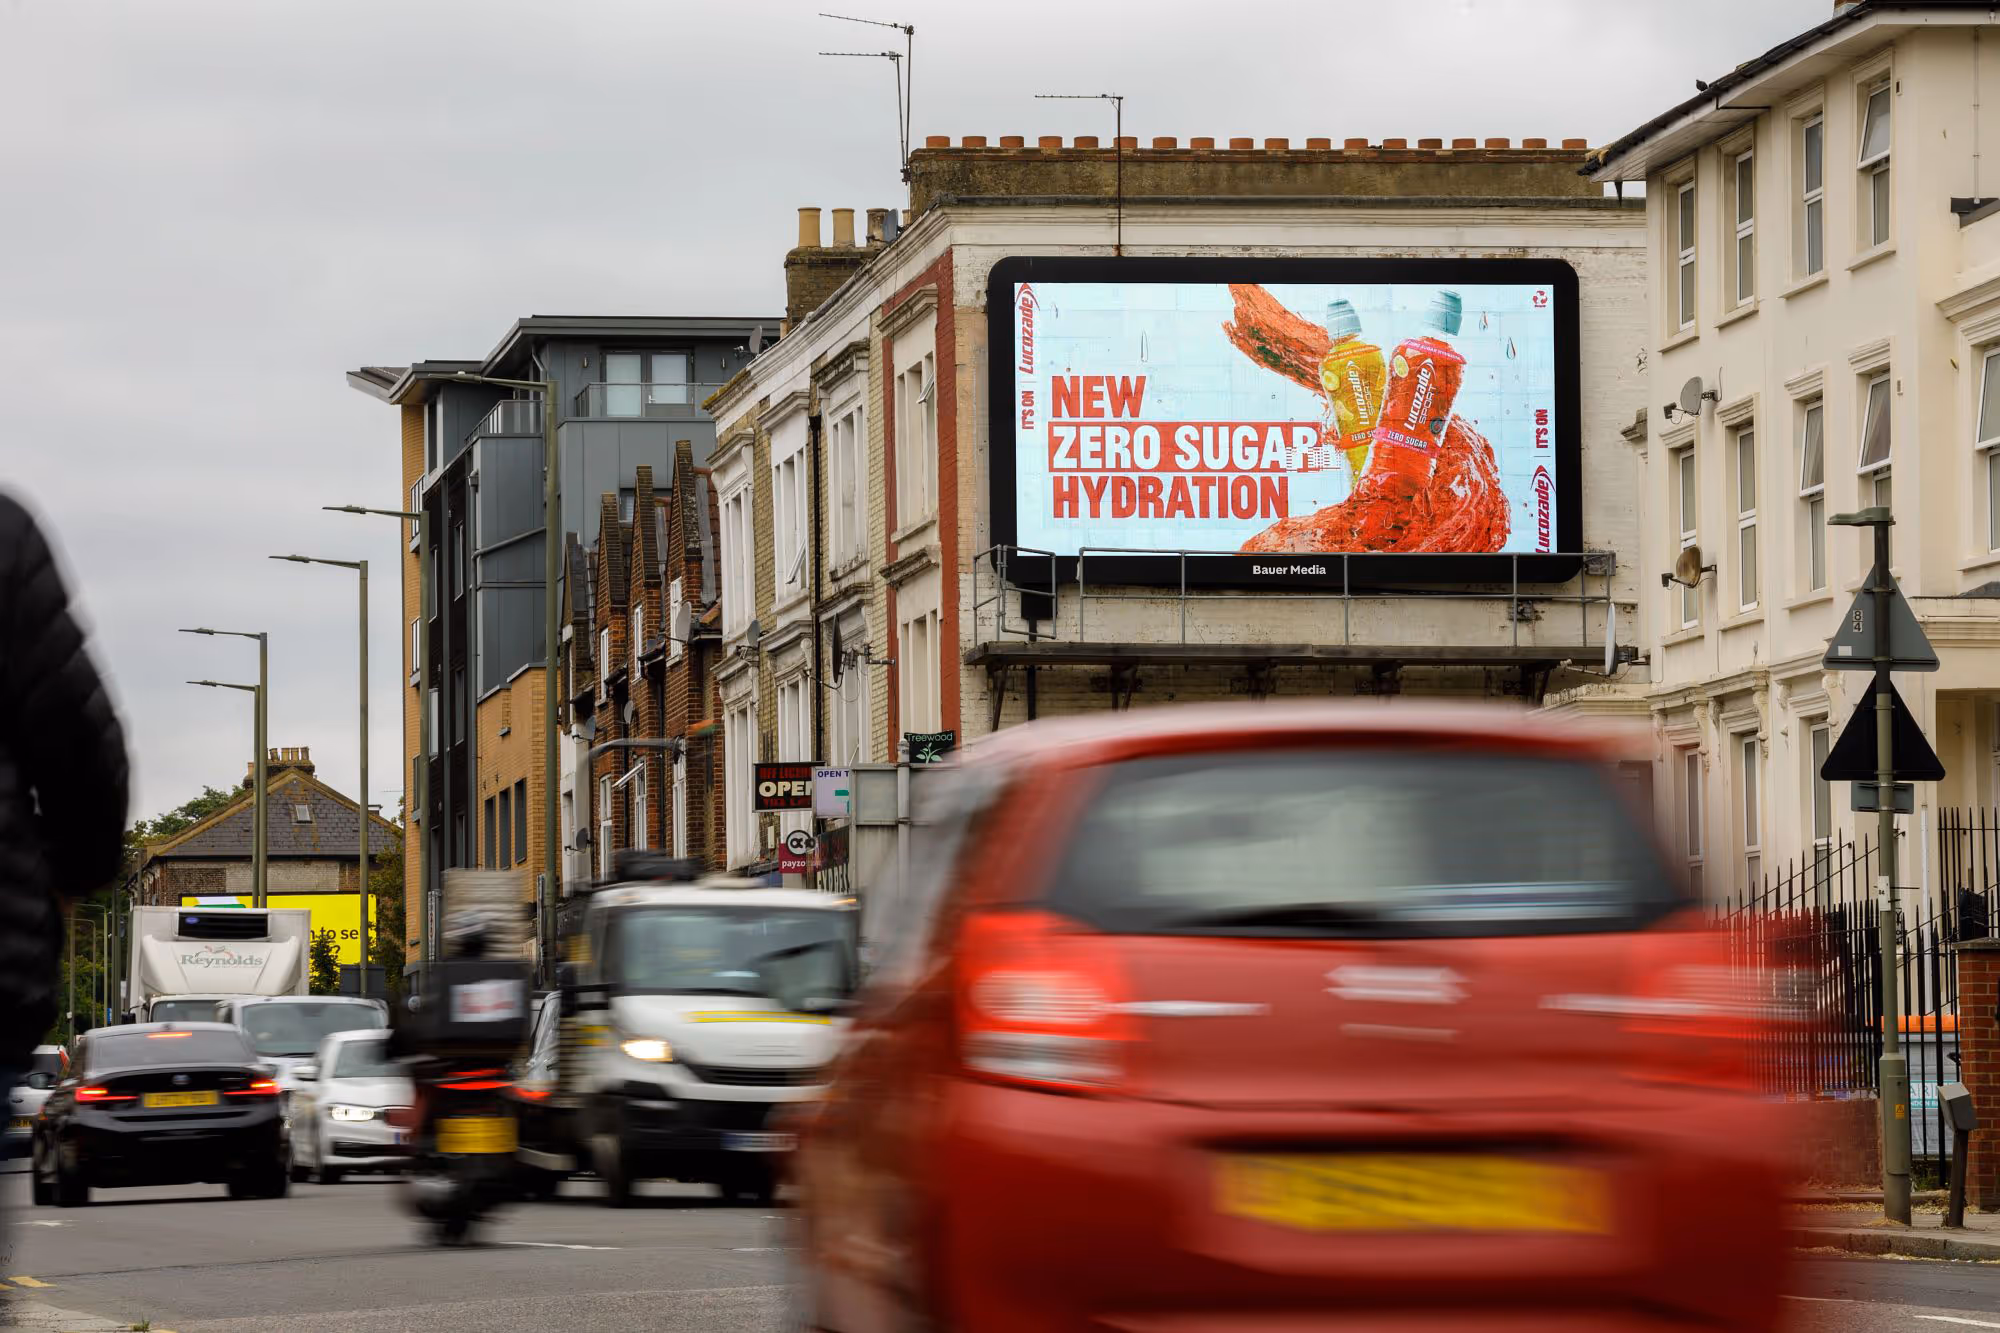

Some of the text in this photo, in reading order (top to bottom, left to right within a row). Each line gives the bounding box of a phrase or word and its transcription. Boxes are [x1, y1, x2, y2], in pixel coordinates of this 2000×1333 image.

[1019, 297, 1034, 375] Lucozade
[1021, 391, 1035, 407] ON
[1051, 375, 1147, 419] NEW
[1404, 367, 1431, 431] Lucozade
[1419, 384, 1437, 425] SPORT
[1535, 409, 1549, 426] ON
[1052, 424, 1319, 470] ZERO SUGAR
[1387, 431, 1404, 442] ZERO
[1405, 436, 1428, 449] SUGAR
[1053, 475, 1289, 519] HYDRATION
[1252, 564, 1327, 575] Bauer Media
[905, 732, 953, 742] Treewood
[817, 770, 842, 778] OPEN
[781, 860, 806, 870] payzo
[340, 929, 361, 941] se
[181, 954, 264, 969] Reynolds
